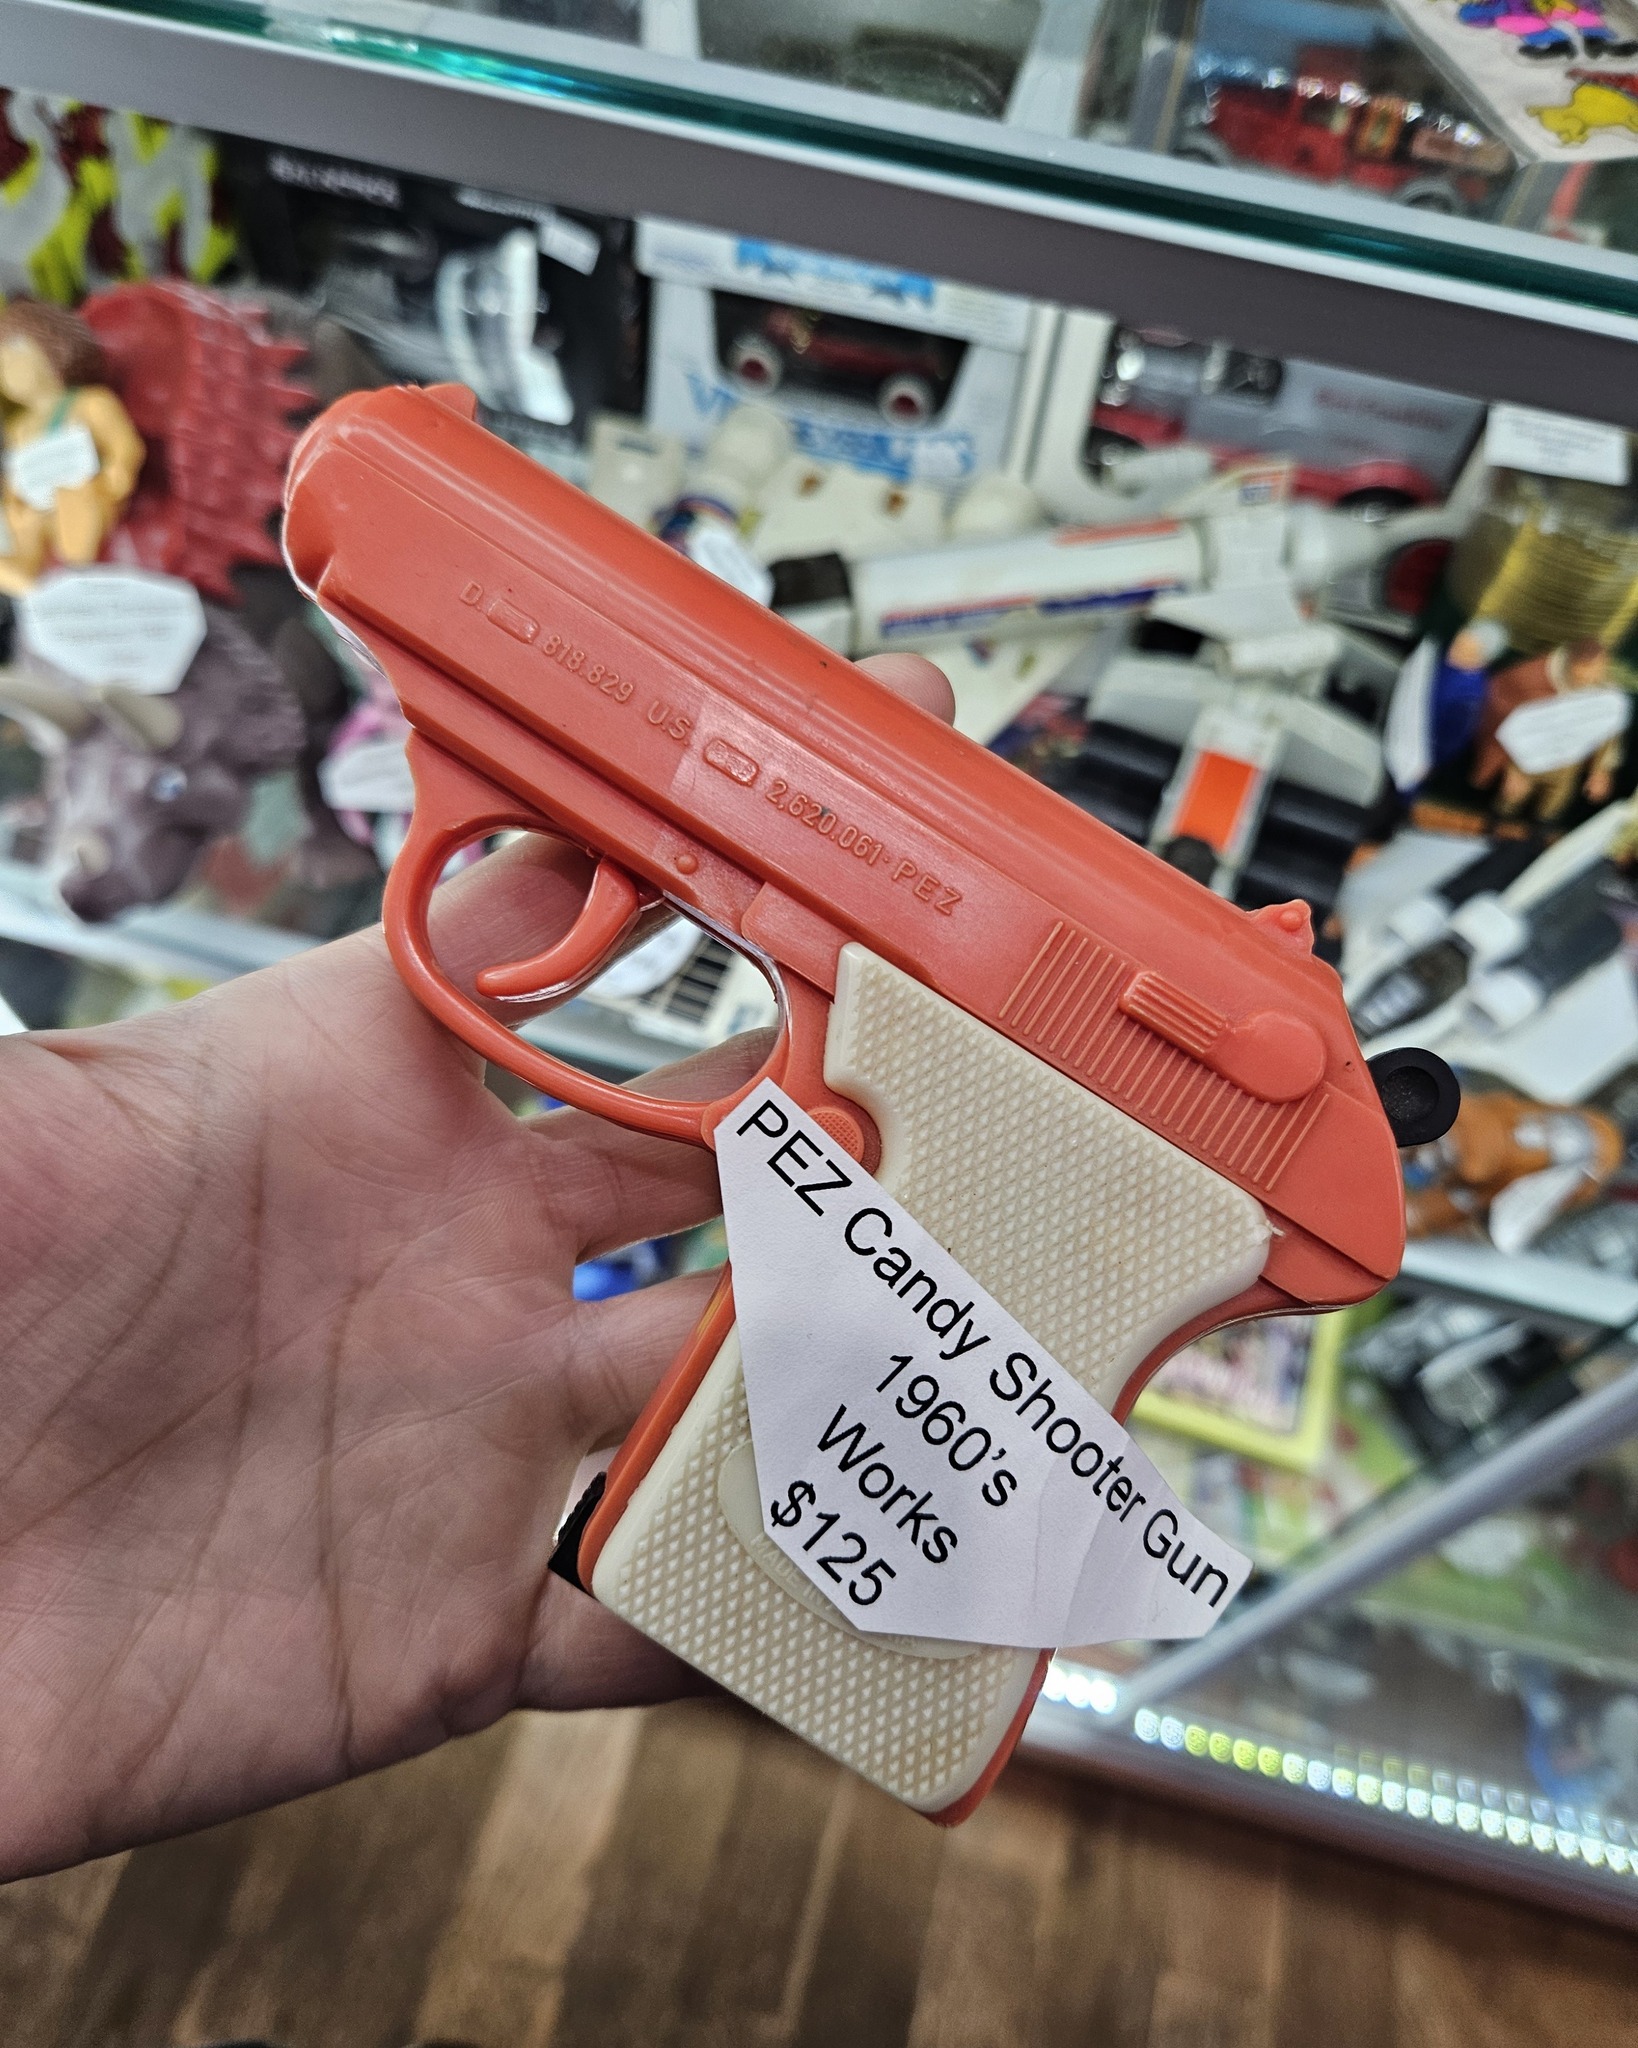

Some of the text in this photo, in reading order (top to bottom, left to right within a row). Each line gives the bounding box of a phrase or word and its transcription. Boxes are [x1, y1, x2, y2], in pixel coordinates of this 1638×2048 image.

[736, 1099, 1229, 1608] PEZ Candy Shooter Gun
[875, 1354, 1018, 1507] 1960's
[770, 1480, 897, 1606] $125
[817, 1403, 958, 1564] Works
